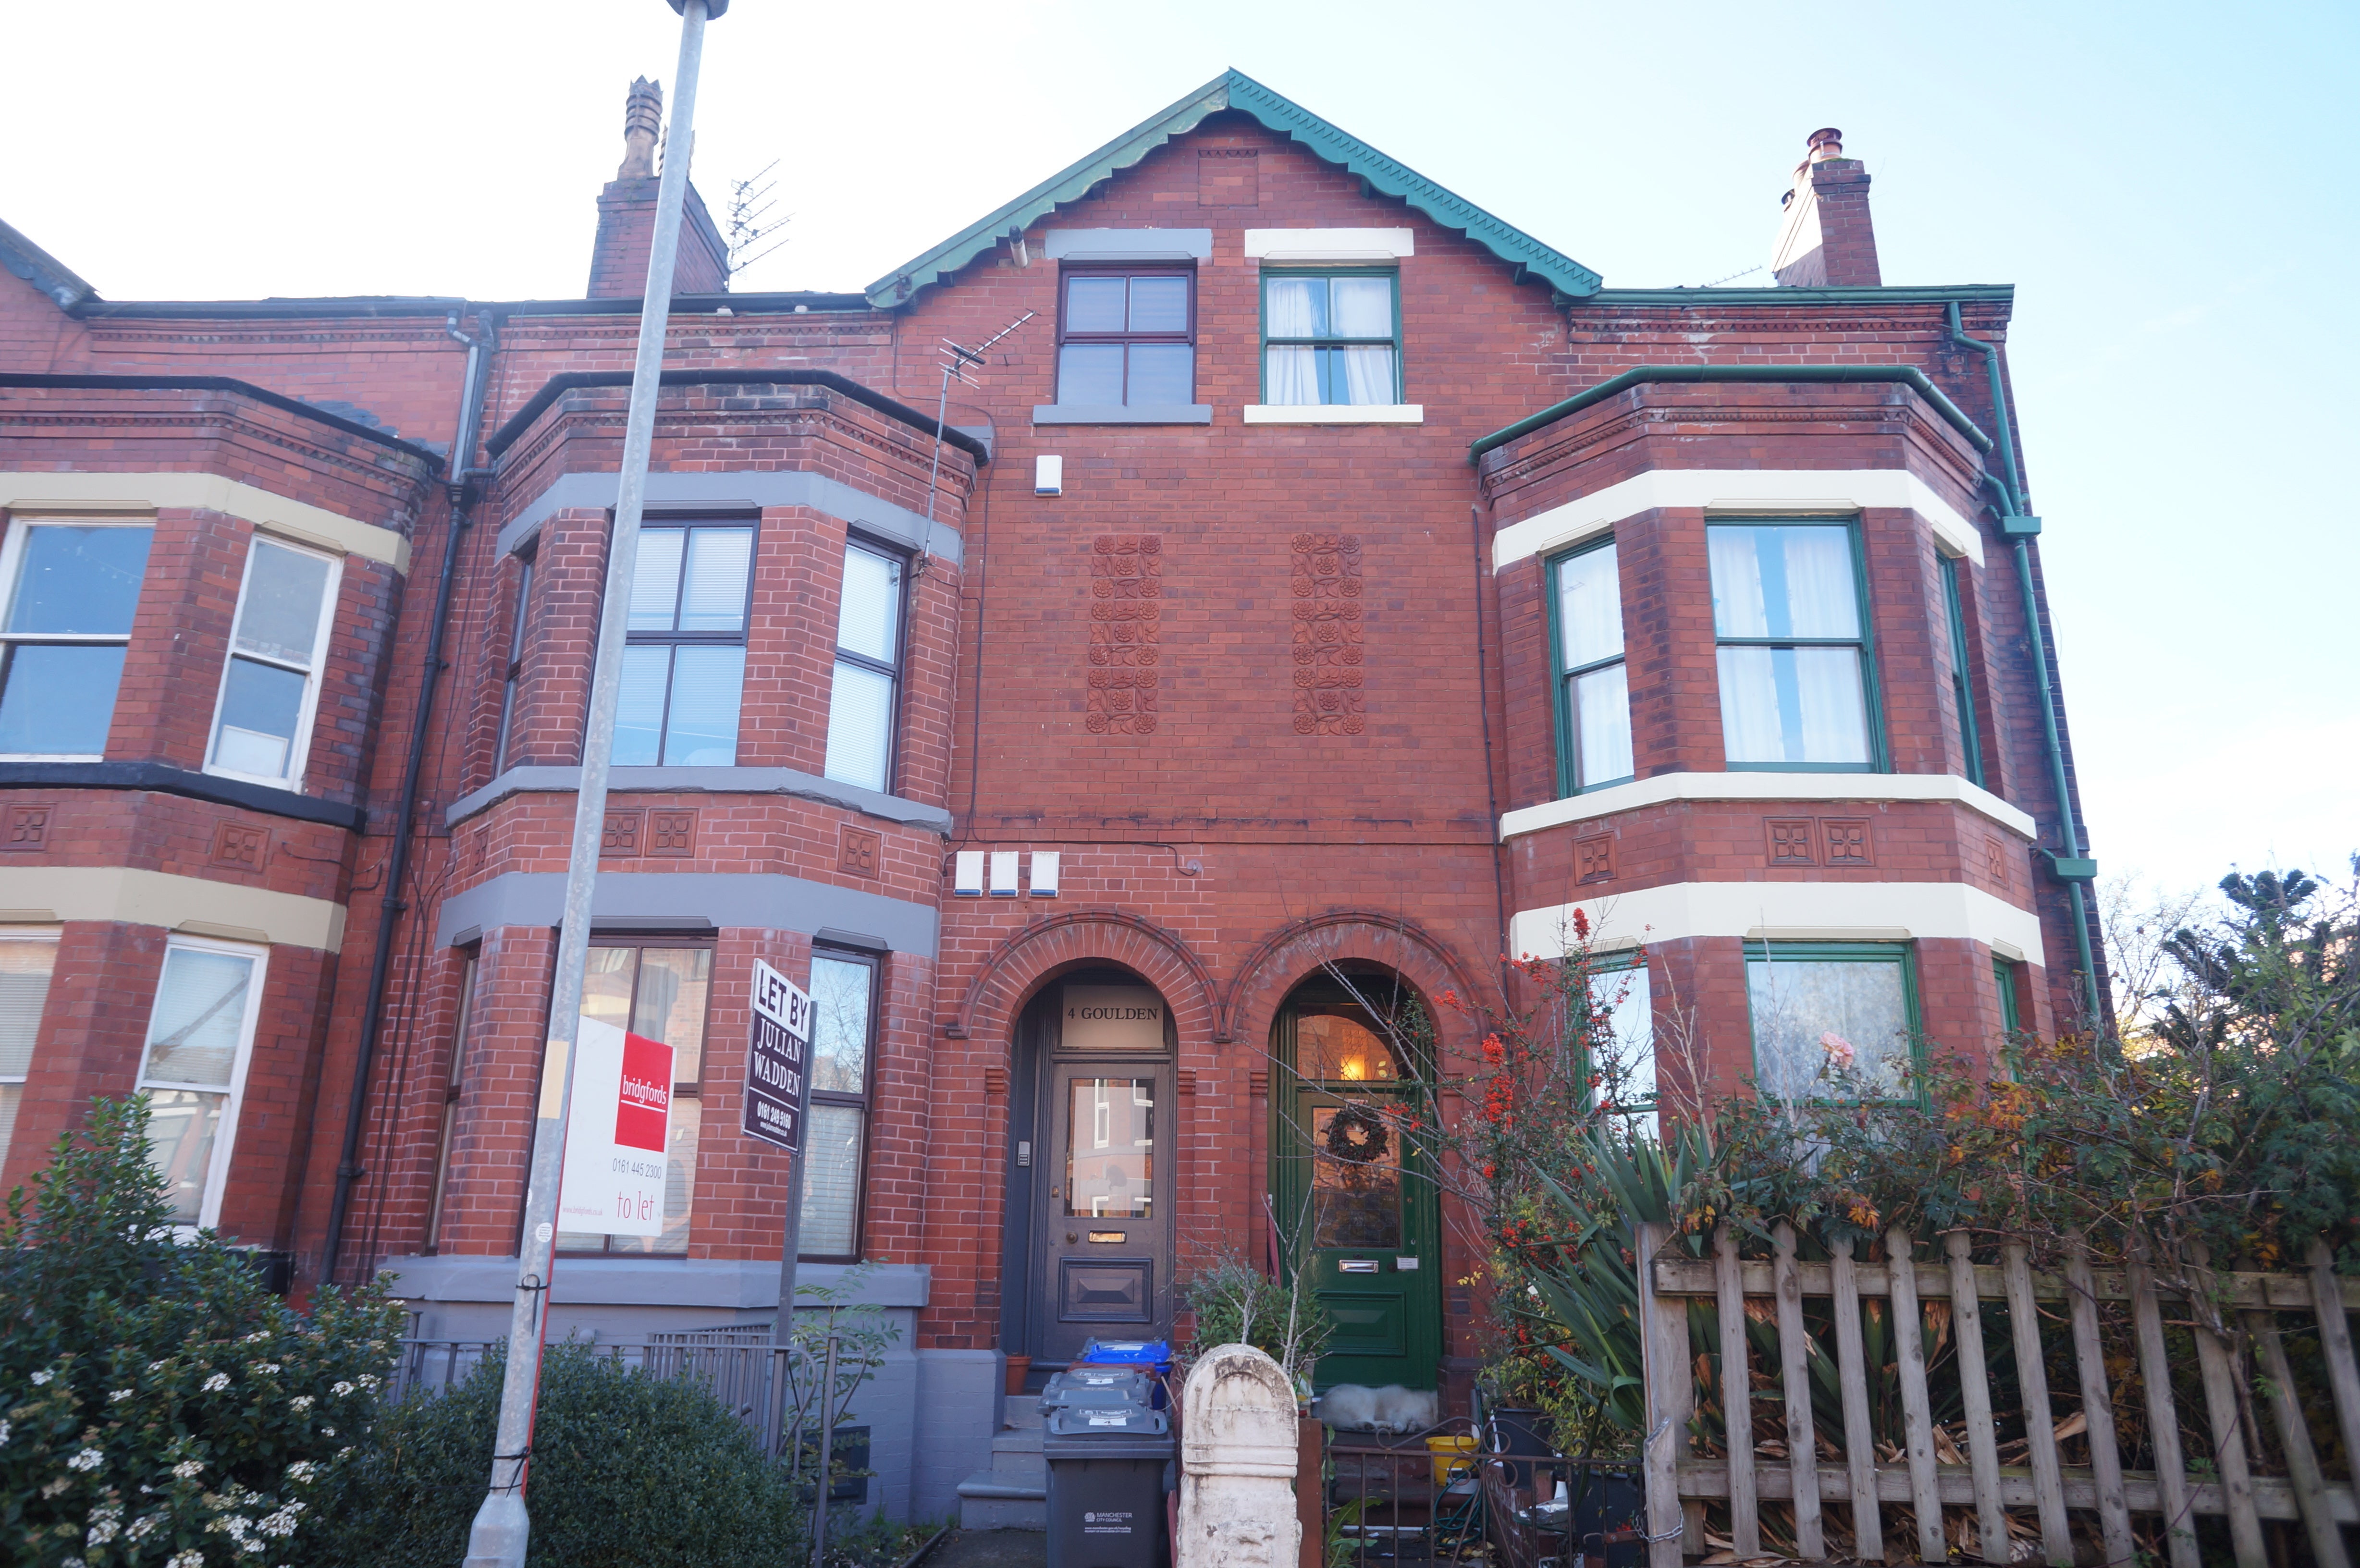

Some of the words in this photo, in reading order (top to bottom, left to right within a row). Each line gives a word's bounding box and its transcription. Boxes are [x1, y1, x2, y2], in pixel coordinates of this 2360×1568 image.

[759, 968, 787, 1018] LET
[789, 991, 808, 1032] BY
[1068, 1007, 1075, 1019] 4
[1082, 1007, 1158, 1020] GOULDEN
[757, 1017, 802, 1065] JULIAN
[622, 1074, 667, 1105] bridgfords
[754, 1051, 801, 1098] WADDEN
[757, 1101, 770, 1120] 0161
[770, 1106, 780, 1125] 249
[780, 1111, 791, 1130] 5160
[612, 1158, 629, 1174] 0161
[631, 1161, 644, 1176] 445
[645, 1164, 662, 1179] 2300
[617, 1191, 631, 1219] to
[637, 1190, 655, 1221] let
